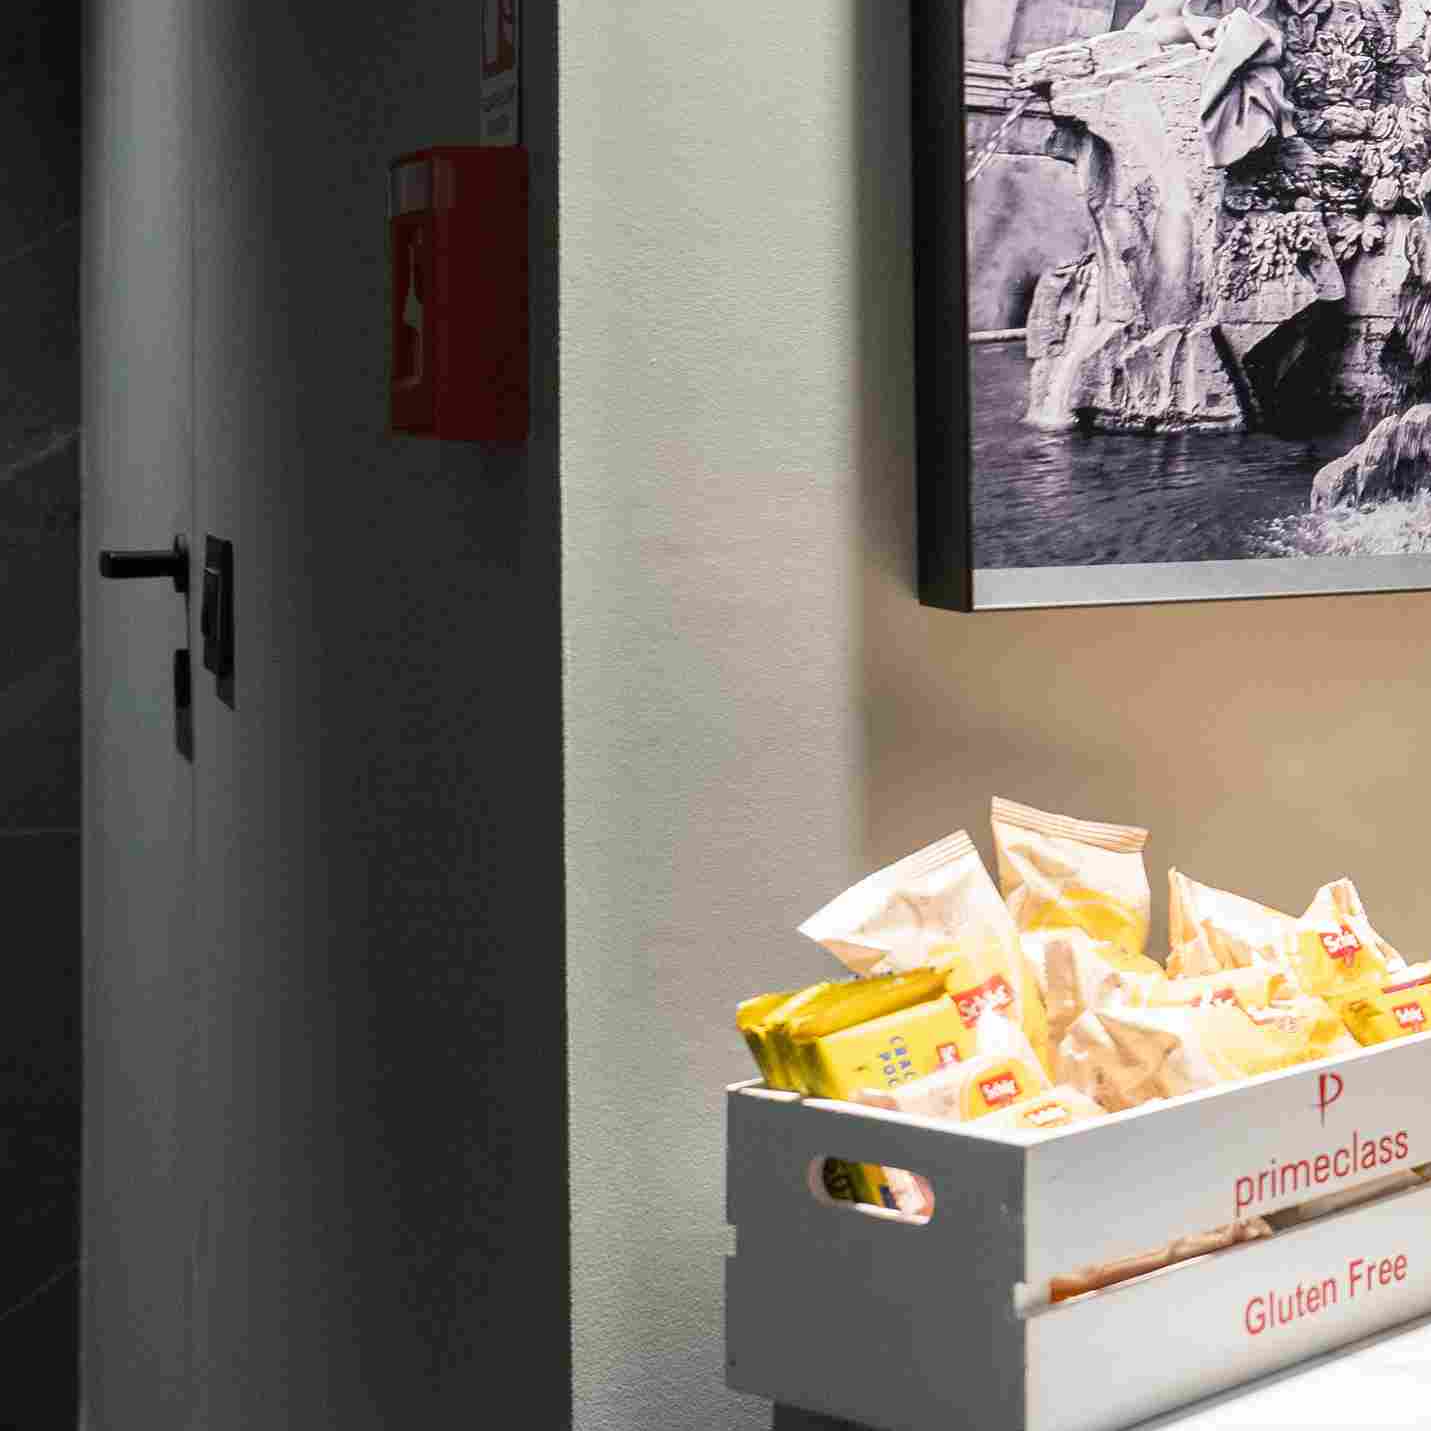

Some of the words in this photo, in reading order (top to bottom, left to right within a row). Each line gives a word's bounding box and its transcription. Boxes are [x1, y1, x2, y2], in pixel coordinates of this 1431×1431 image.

[1235, 1129, 1409, 1218] primeclass
[1245, 1274, 1337, 1335] Gluten
[1349, 1254, 1408, 1298] Free
